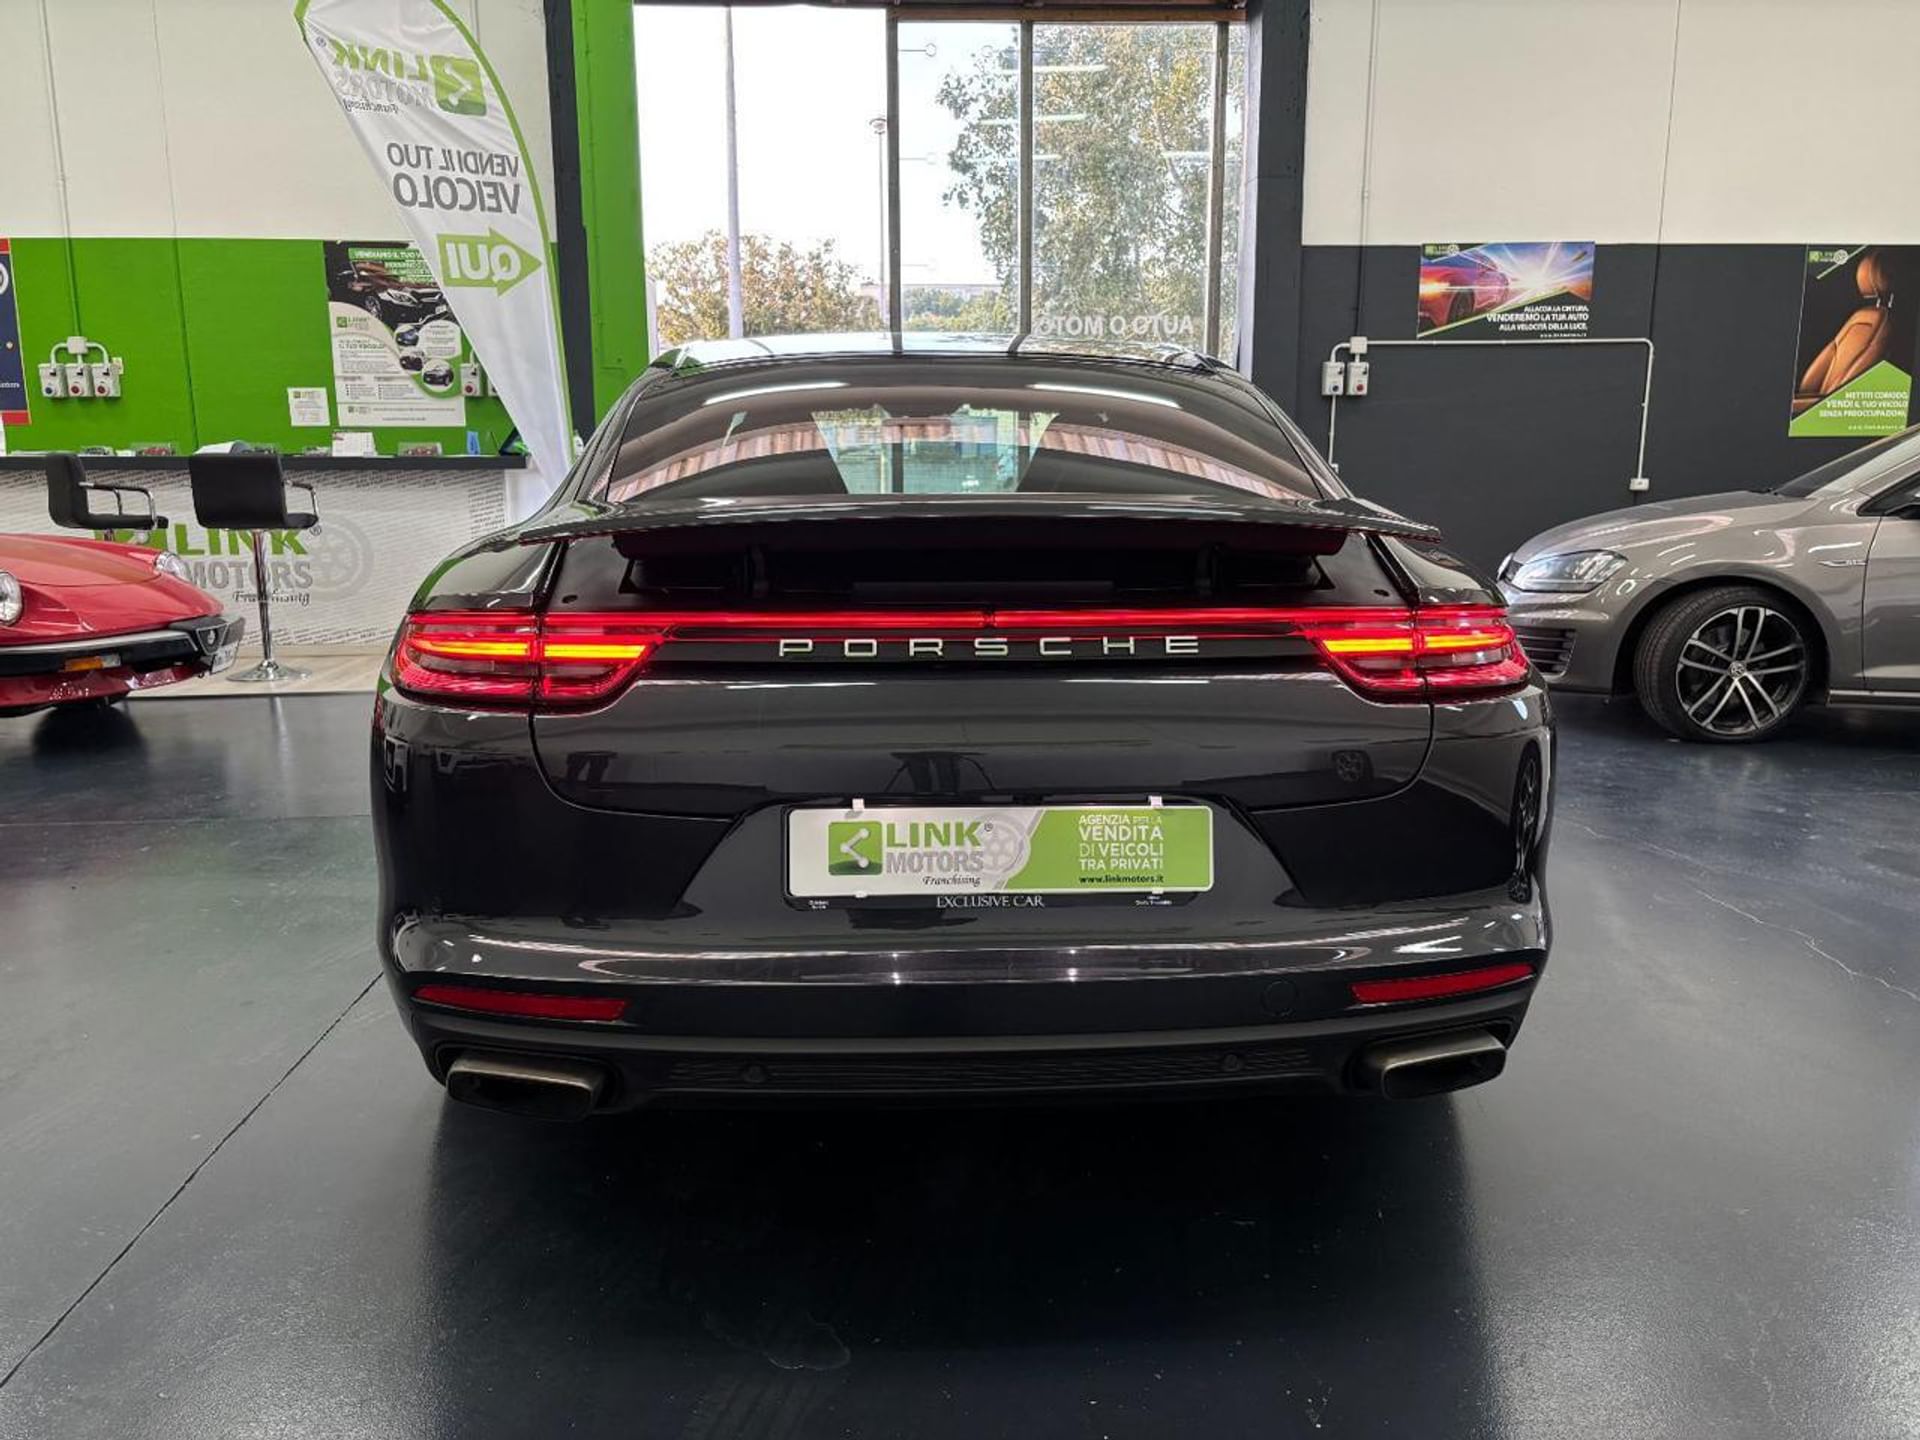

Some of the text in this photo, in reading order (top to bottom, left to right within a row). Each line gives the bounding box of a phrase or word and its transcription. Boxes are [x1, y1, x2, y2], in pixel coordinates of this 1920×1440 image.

[1486, 312, 1540, 322] VENDEREMO
[1541, 313, 1551, 321] LA
[1567, 312, 1590, 321] AUTO
[1499, 323, 1516, 331] ALLA
[173, 523, 308, 555] LINK
[778, 635, 1200, 657] PORSCHE
[1079, 814, 1130, 825] AGENZIA
[886, 821, 982, 848] LINK
[1079, 825, 1164, 841] VENDITA
[1080, 842, 1164, 857] DI VEICOLI
[886, 851, 984, 873] MOTORS
[1079, 858, 1164, 871] TRA PRIVATI
[922, 874, 981, 887] Franchising
[1079, 874, 1164, 884] www.linkmotors.it
[936, 896, 1045, 909] EXCLUSIVE CAR
